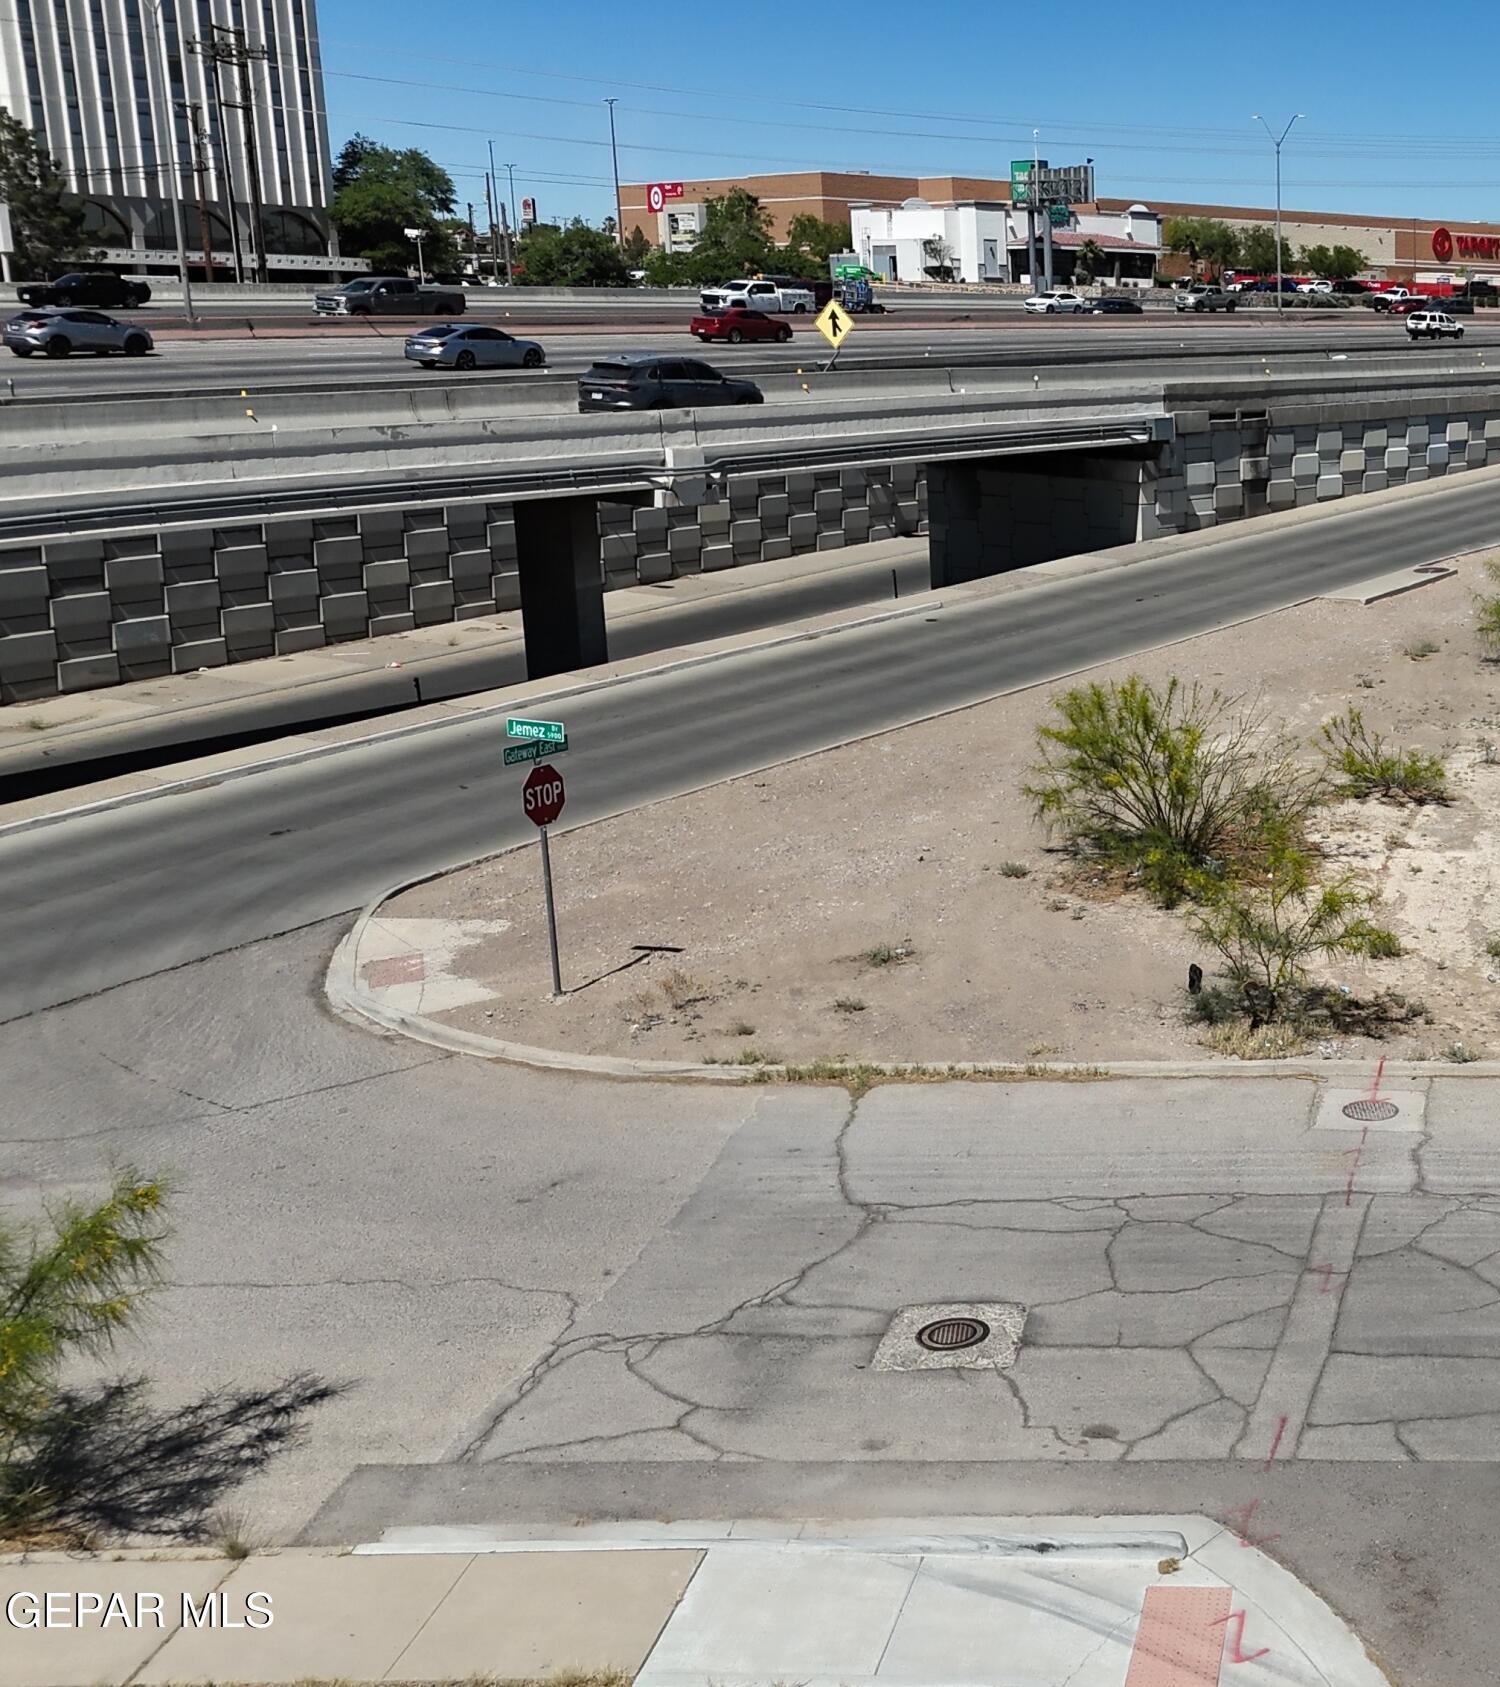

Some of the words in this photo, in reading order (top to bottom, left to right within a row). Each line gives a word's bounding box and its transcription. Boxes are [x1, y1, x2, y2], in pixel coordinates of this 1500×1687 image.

[510, 721, 545, 738] Jemez
[504, 746, 537, 763] Gateway
[540, 740, 556, 756] East
[526, 781, 562, 810] STOP
